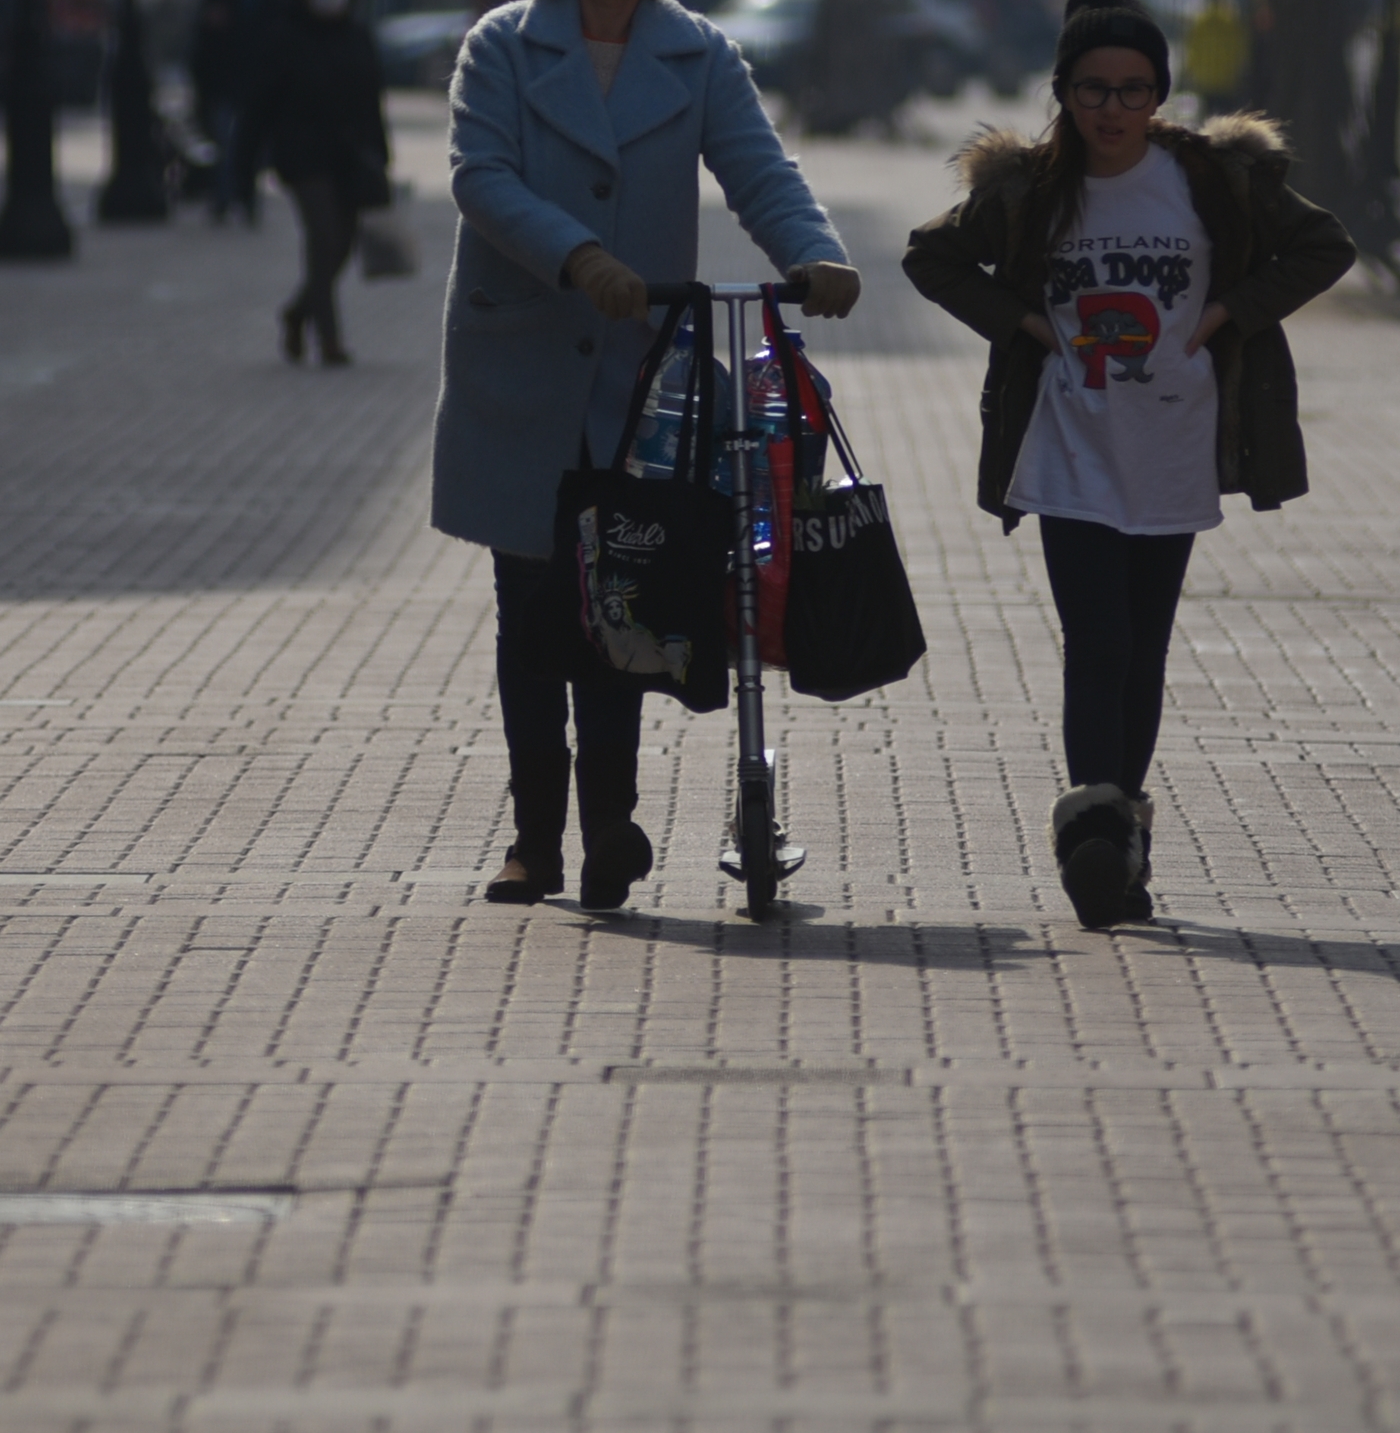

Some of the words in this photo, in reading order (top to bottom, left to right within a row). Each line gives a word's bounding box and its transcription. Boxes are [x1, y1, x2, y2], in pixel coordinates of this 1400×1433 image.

[1058, 236, 1191, 253] ORTLAND
[1101, 252, 1193, 311] Dogs
[606, 512, 666, 546] Kiehl's
